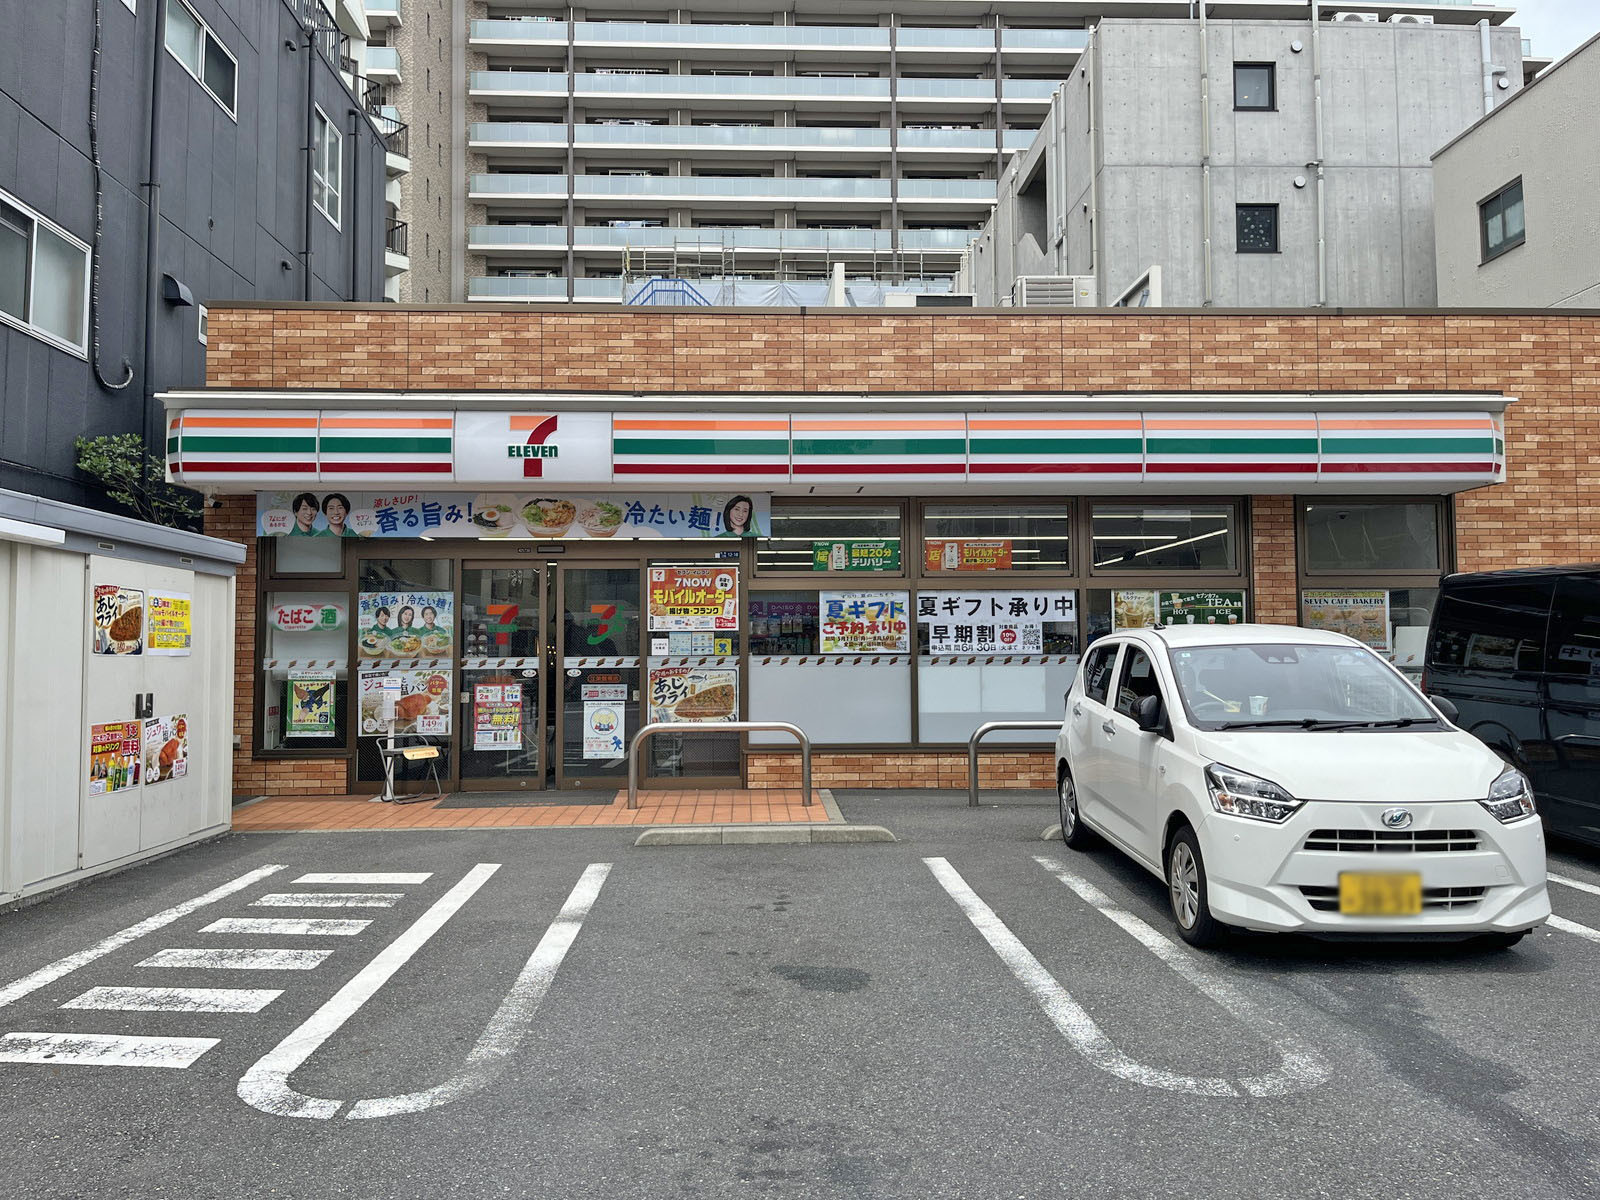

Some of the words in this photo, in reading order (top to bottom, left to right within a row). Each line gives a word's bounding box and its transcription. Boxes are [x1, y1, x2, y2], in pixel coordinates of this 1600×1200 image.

[375, 501, 474, 534] 香る旨み!
[623, 500, 722, 532] 冷たい麺!
[852, 558, 891, 567] デリバリー
[674, 577, 712, 587] 7NOW
[96, 595, 116, 614] あじ
[653, 589, 733, 604] モバイルオーダー
[1206, 598, 1233, 607] TEA
[825, 599, 905, 619] 夏ギフト
[918, 595, 1073, 618] 夏ギフト承り中
[96, 605, 118, 628] フライ
[277, 608, 314, 625] たばこ
[320, 608, 337, 625] 酒
[822, 620, 907, 635] ご予約承り中
[931, 624, 996, 644] 早期割
[653, 677, 684, 695] あじ
[653, 686, 689, 707] フライ
